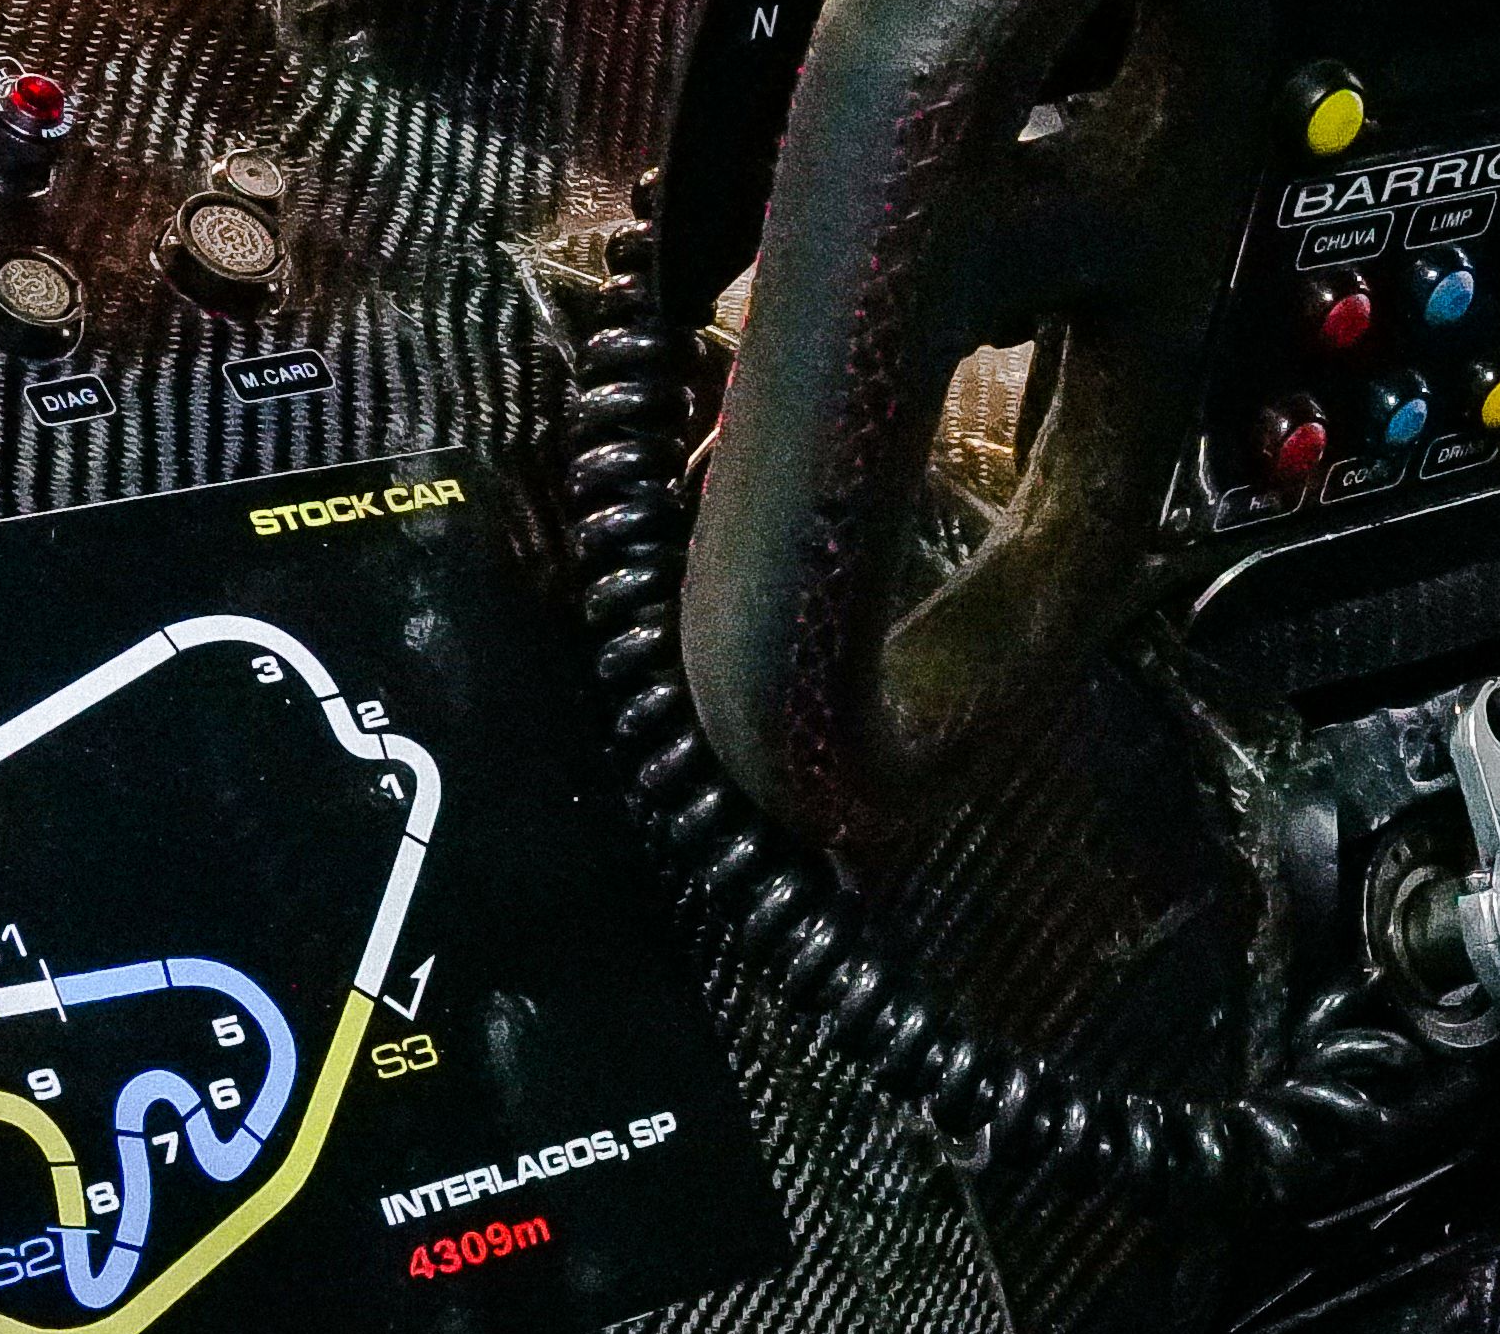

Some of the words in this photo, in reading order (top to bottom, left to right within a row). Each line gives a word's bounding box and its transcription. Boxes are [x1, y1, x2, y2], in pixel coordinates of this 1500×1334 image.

[1429, 208, 1474, 232] LIMP
[1313, 227, 1377, 254] CHUVA
[239, 362, 319, 389] M.CARD
[41, 388, 98, 412] DIAG
[249, 491, 385, 535] STOCK
[383, 478, 466, 513] CAR
[252, 655, 284, 685] 3
[357, 700, 390, 728] 2
[380, 773, 406, 801] 1
[213, 1015, 246, 1049] 5
[370, 1034, 440, 1079] S3
[27, 1069, 62, 1101] 9
[211, 1078, 243, 1110] 6
[152, 1131, 183, 1165] 7
[380, 1130, 633, 1227] INTERLAGOS,
[628, 1110, 678, 1151] SP
[86, 1181, 121, 1215] 8
[408, 1214, 554, 1282] 4309m
